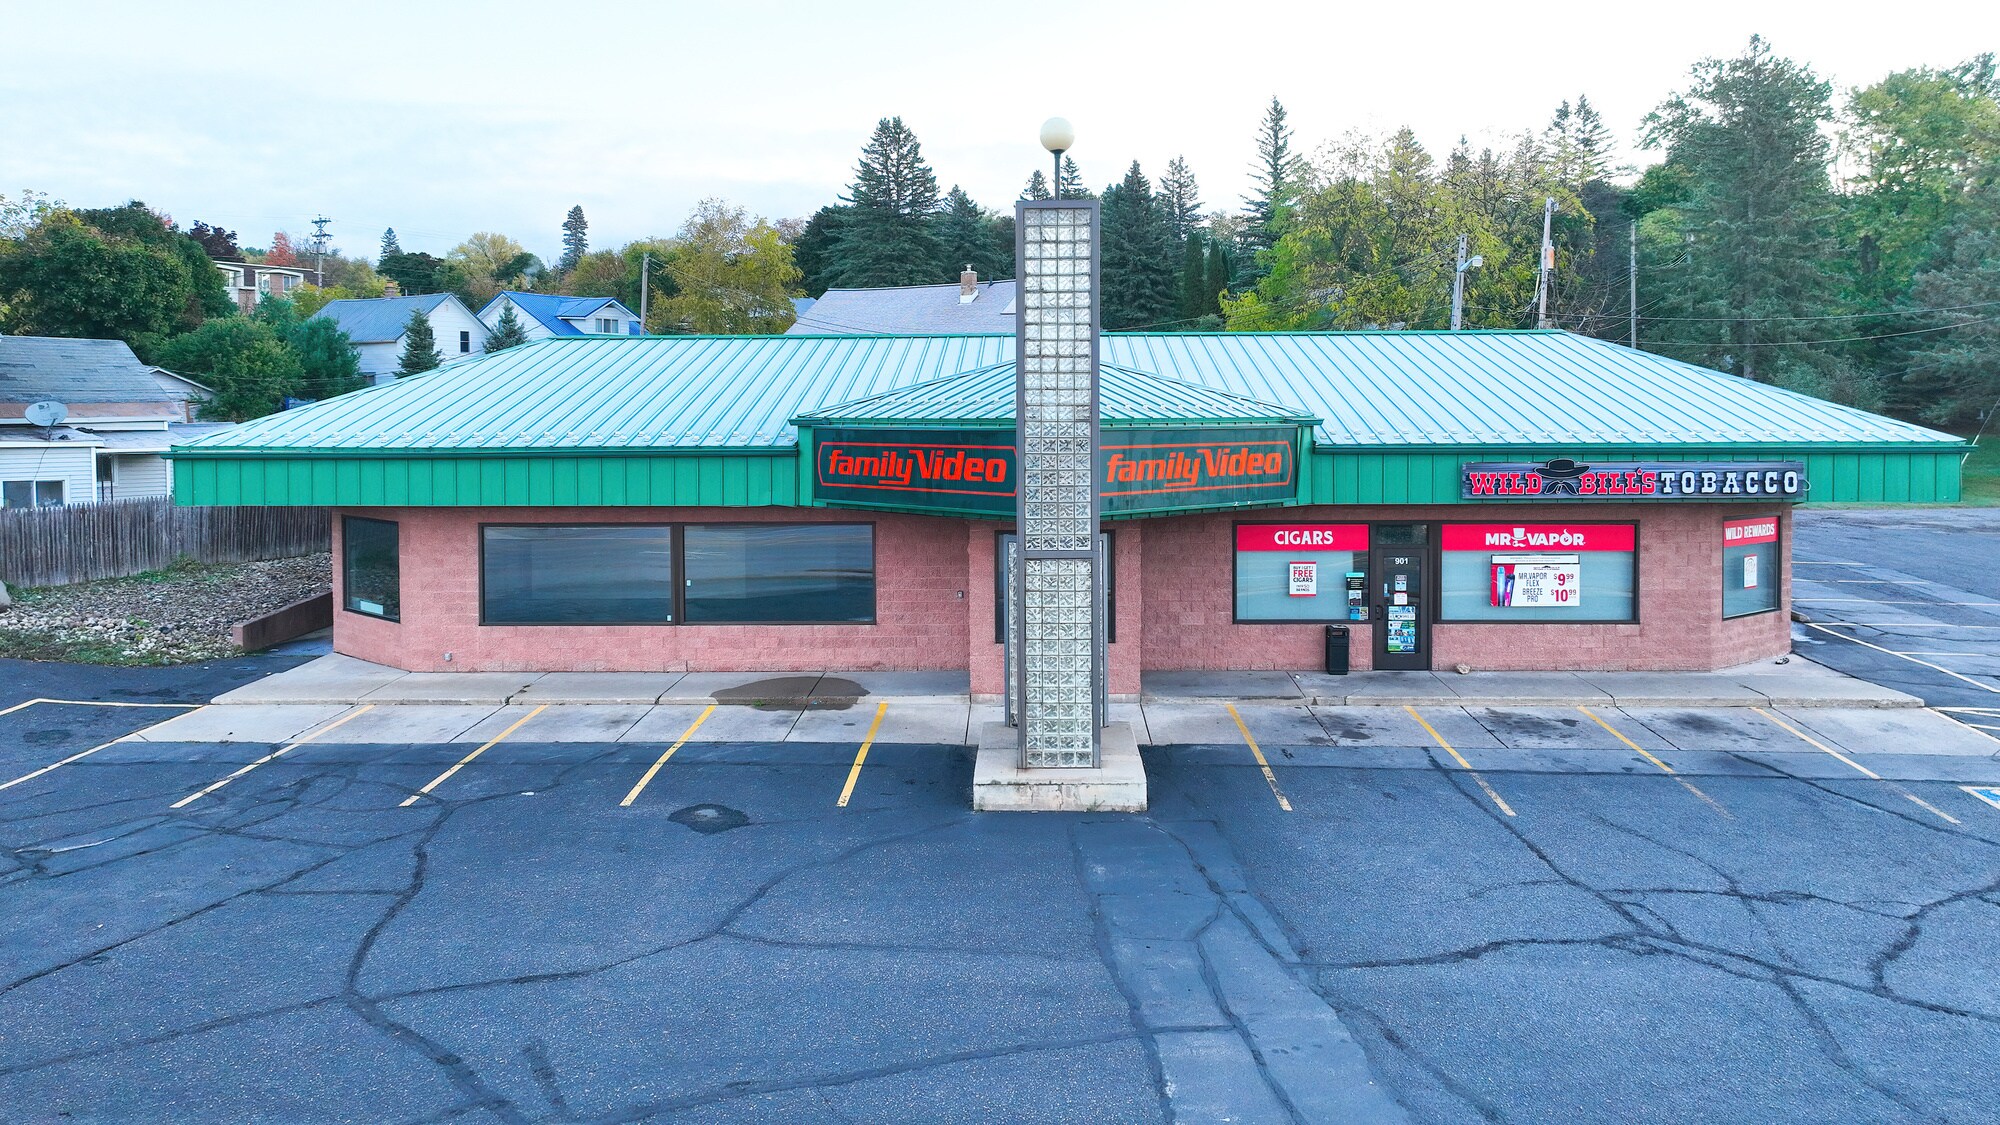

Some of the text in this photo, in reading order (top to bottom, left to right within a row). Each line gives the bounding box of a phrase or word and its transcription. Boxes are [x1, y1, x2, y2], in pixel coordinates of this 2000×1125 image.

[1469, 467, 1798, 495] WILD BILL'S TOBACCO
[1725, 523, 1775, 541] WILD REWARDS
[1274, 530, 1334, 545] CIGARS
[1485, 528, 1585, 546] MR VAPOR
[1394, 557, 1409, 565] 901
[1293, 569, 1314, 578] FREE
[1525, 579, 1540, 587] FLEX
[1522, 588, 1543, 596] BREEZE
[1526, 595, 1539, 603] PRO
